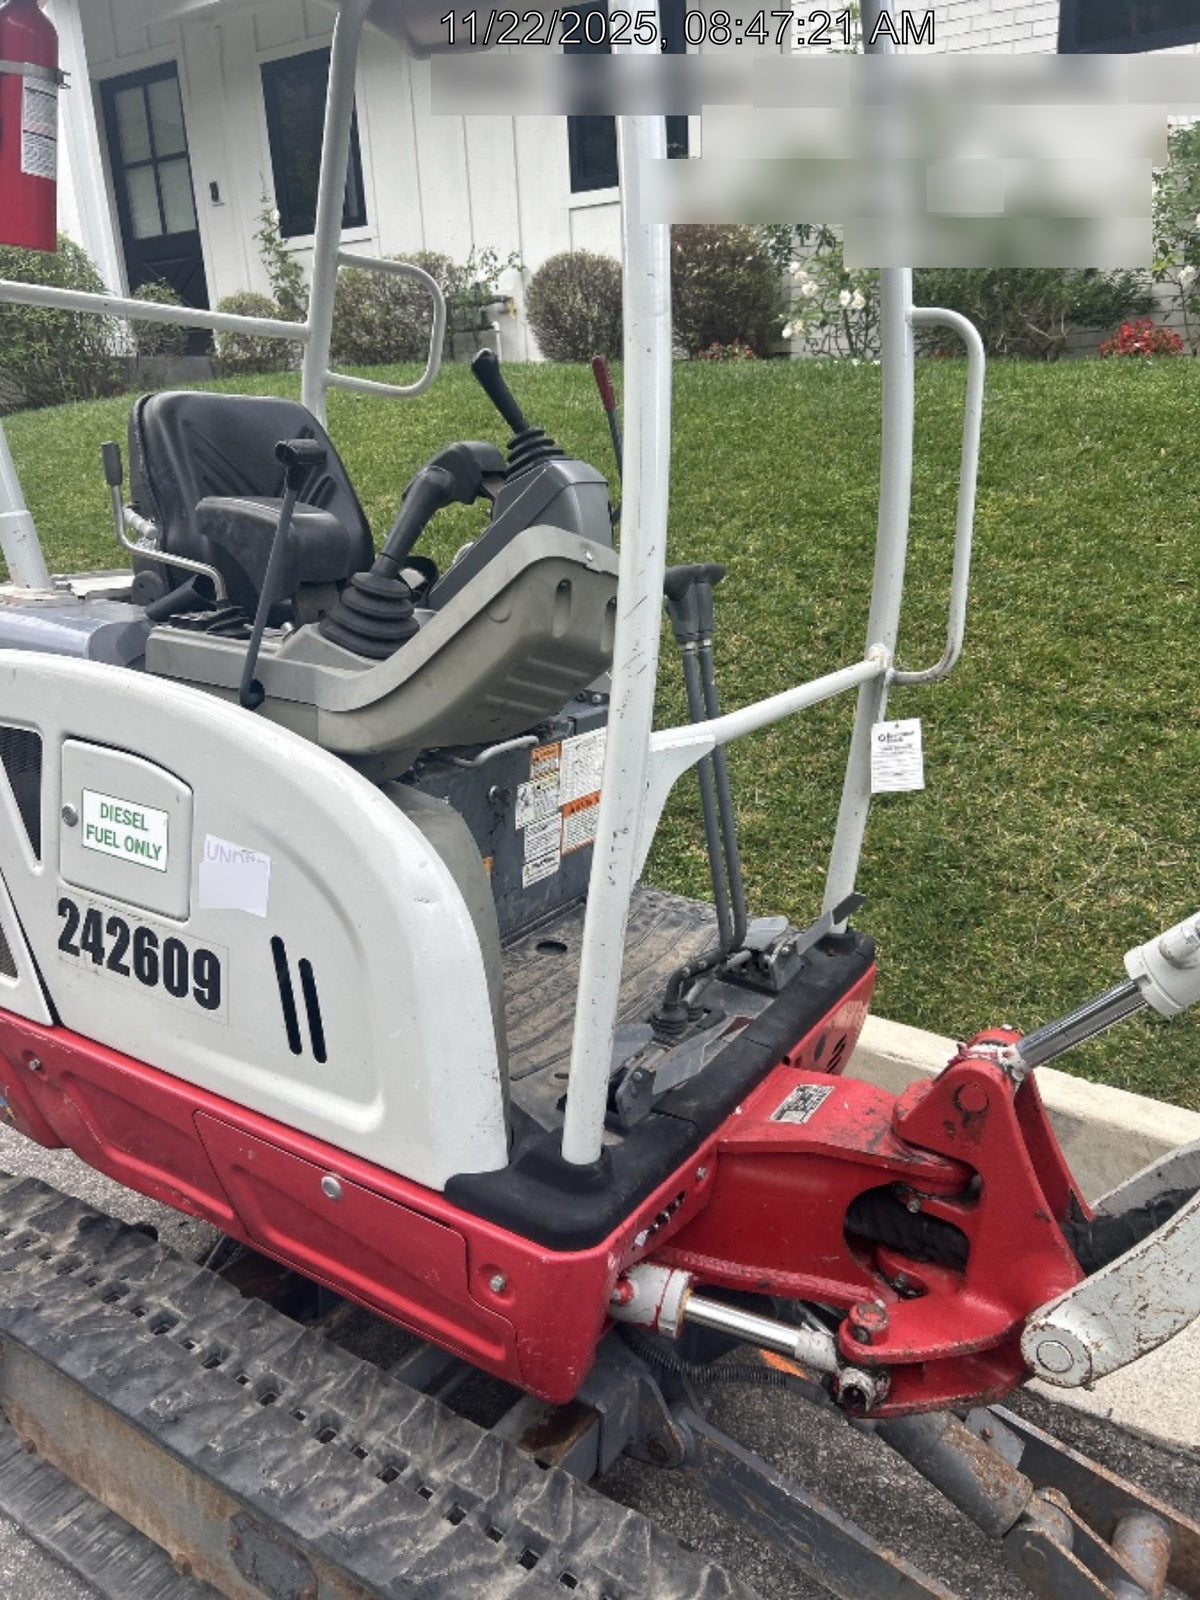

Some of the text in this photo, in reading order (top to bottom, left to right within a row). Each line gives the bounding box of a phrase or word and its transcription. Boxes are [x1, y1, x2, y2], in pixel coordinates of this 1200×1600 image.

[100, 802, 149, 832] DIESEL
[86, 823, 162, 861] FUEL ONLY
[57, 897, 222, 1011] 242609
